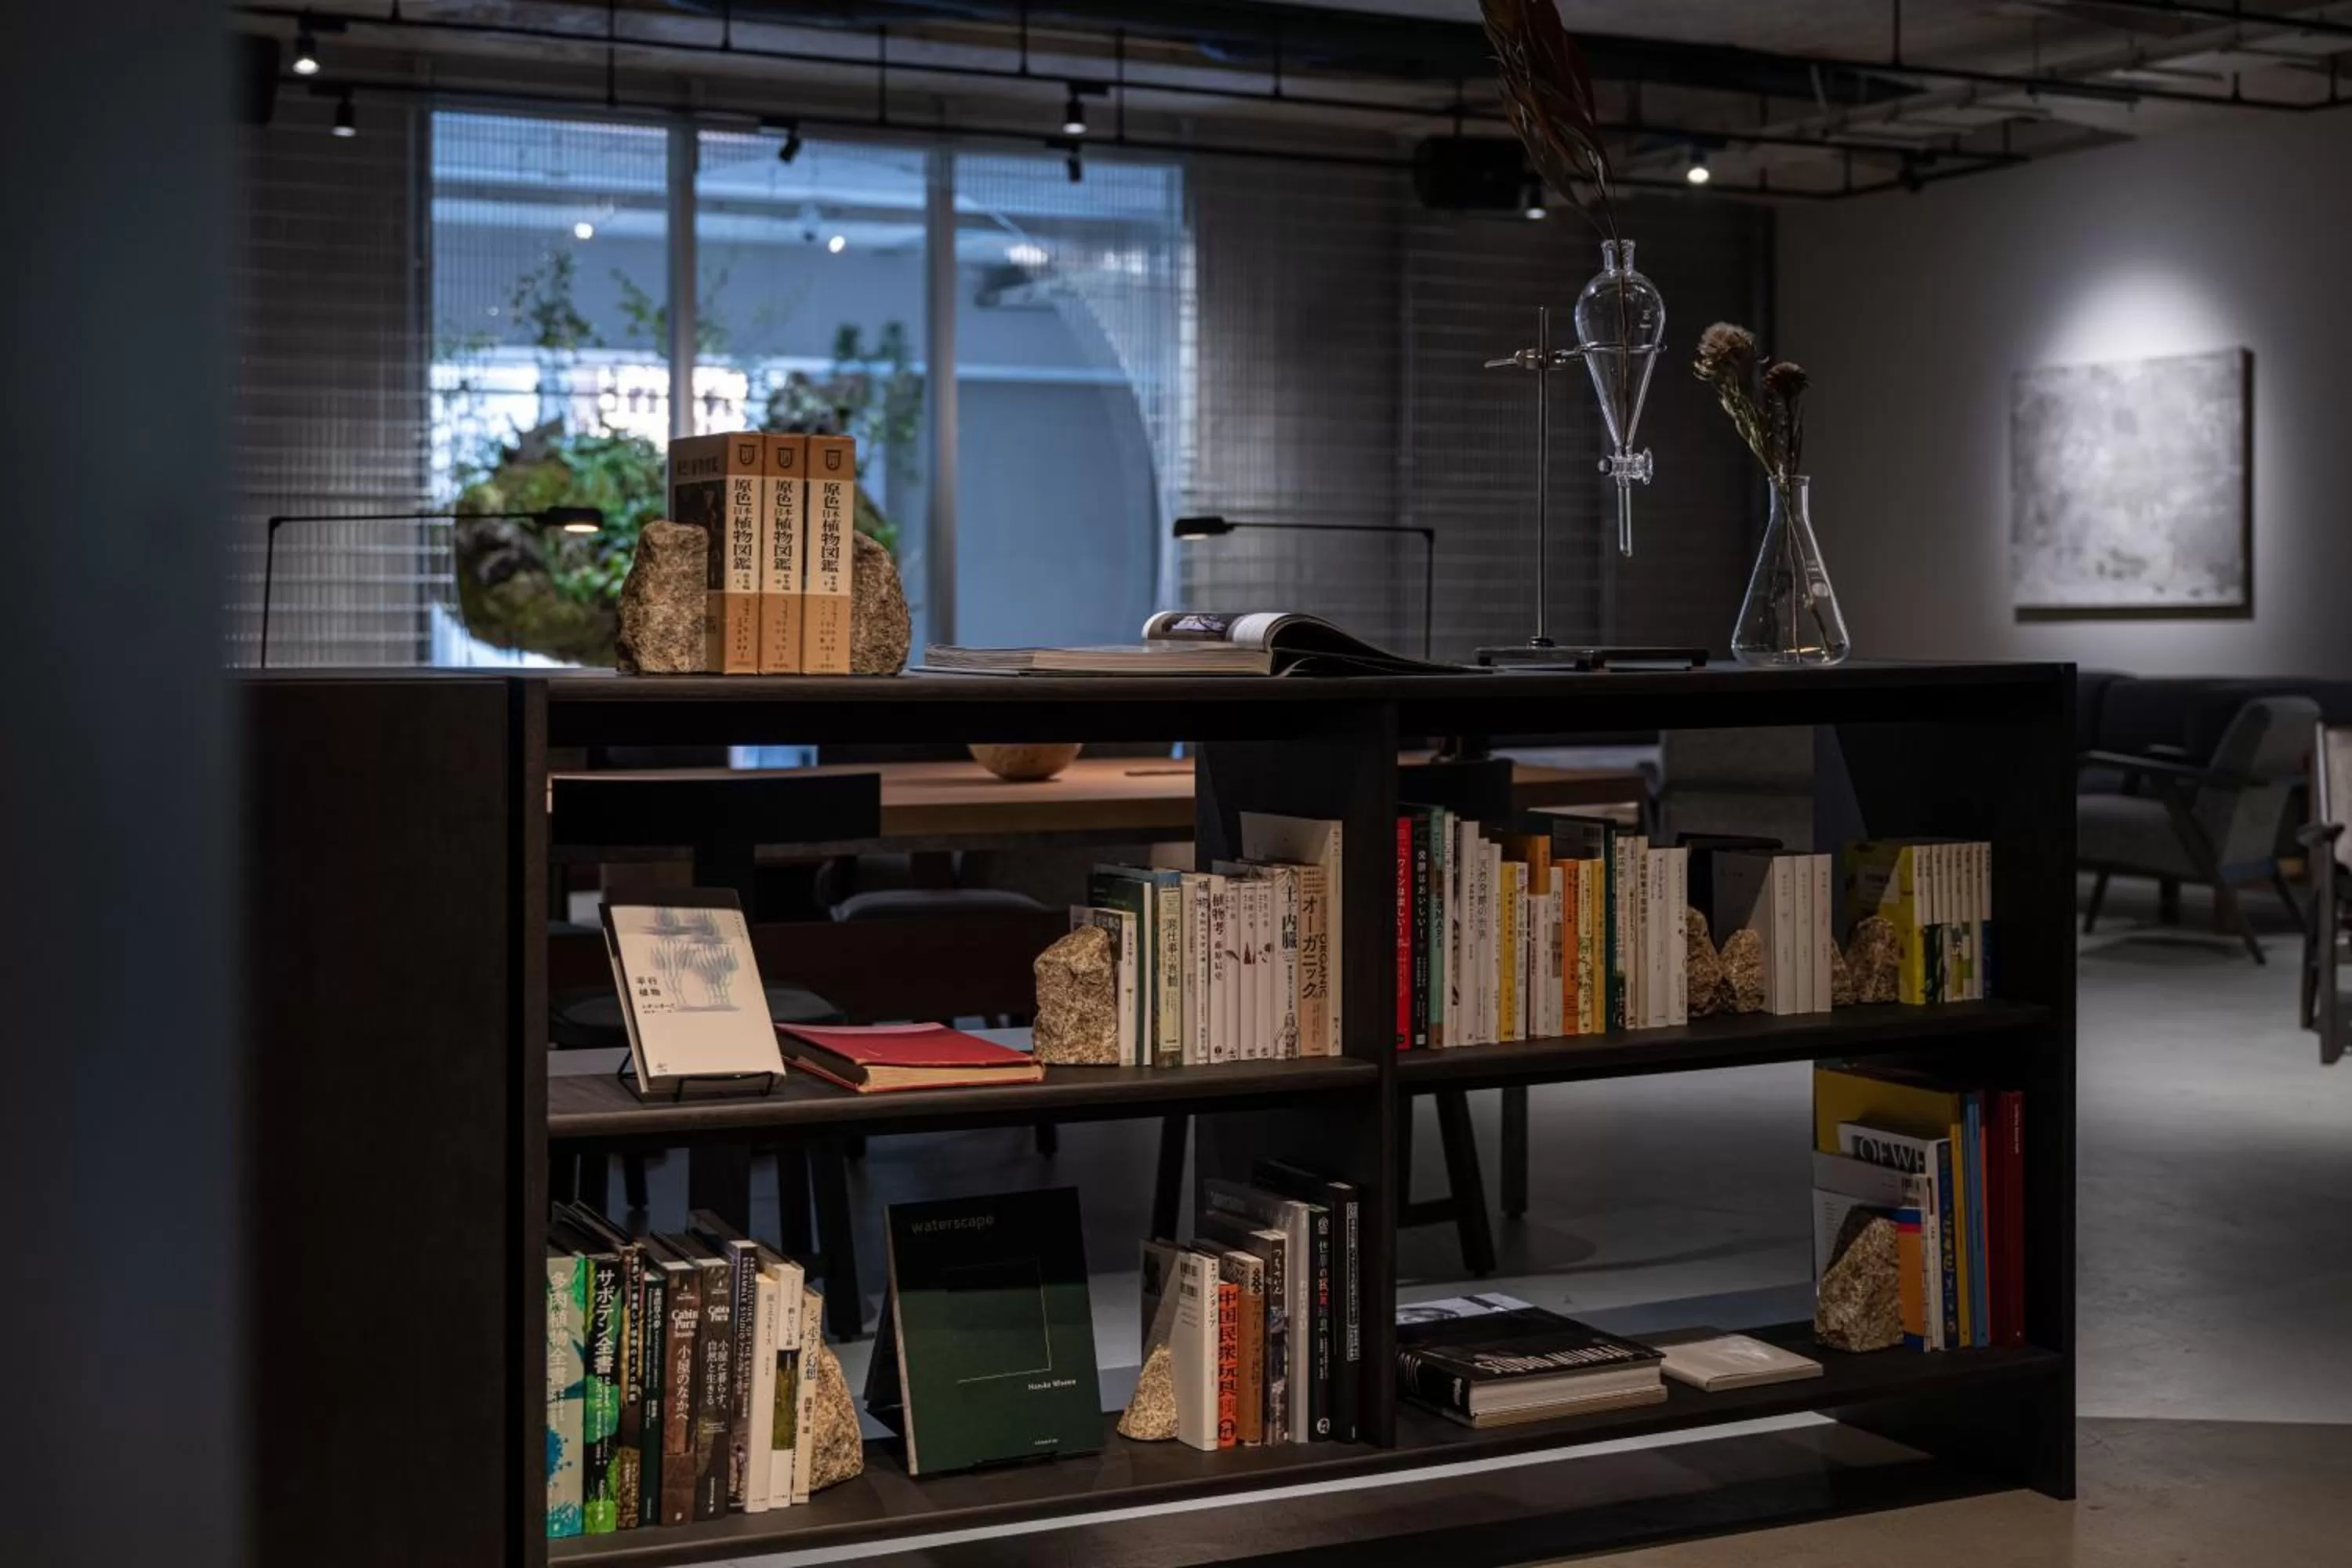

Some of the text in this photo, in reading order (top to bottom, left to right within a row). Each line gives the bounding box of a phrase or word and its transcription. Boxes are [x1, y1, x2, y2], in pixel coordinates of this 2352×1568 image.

[733, 478, 754, 571] 原色日本植物図鑑
[773, 479, 794, 572] 原色日本植物図鑑
[821, 482, 841, 573] 原色日本植物図鑑
[1301, 895, 1319, 1000] オーガニック
[911, 1214, 996, 1235] waterscape
[548, 1270, 570, 1386] 多肉植物全書
[593, 1269, 616, 1374] サボテン全書
[672, 1308, 699, 1319] Cabin
[675, 1344, 692, 1421] 小屋のなかへ
